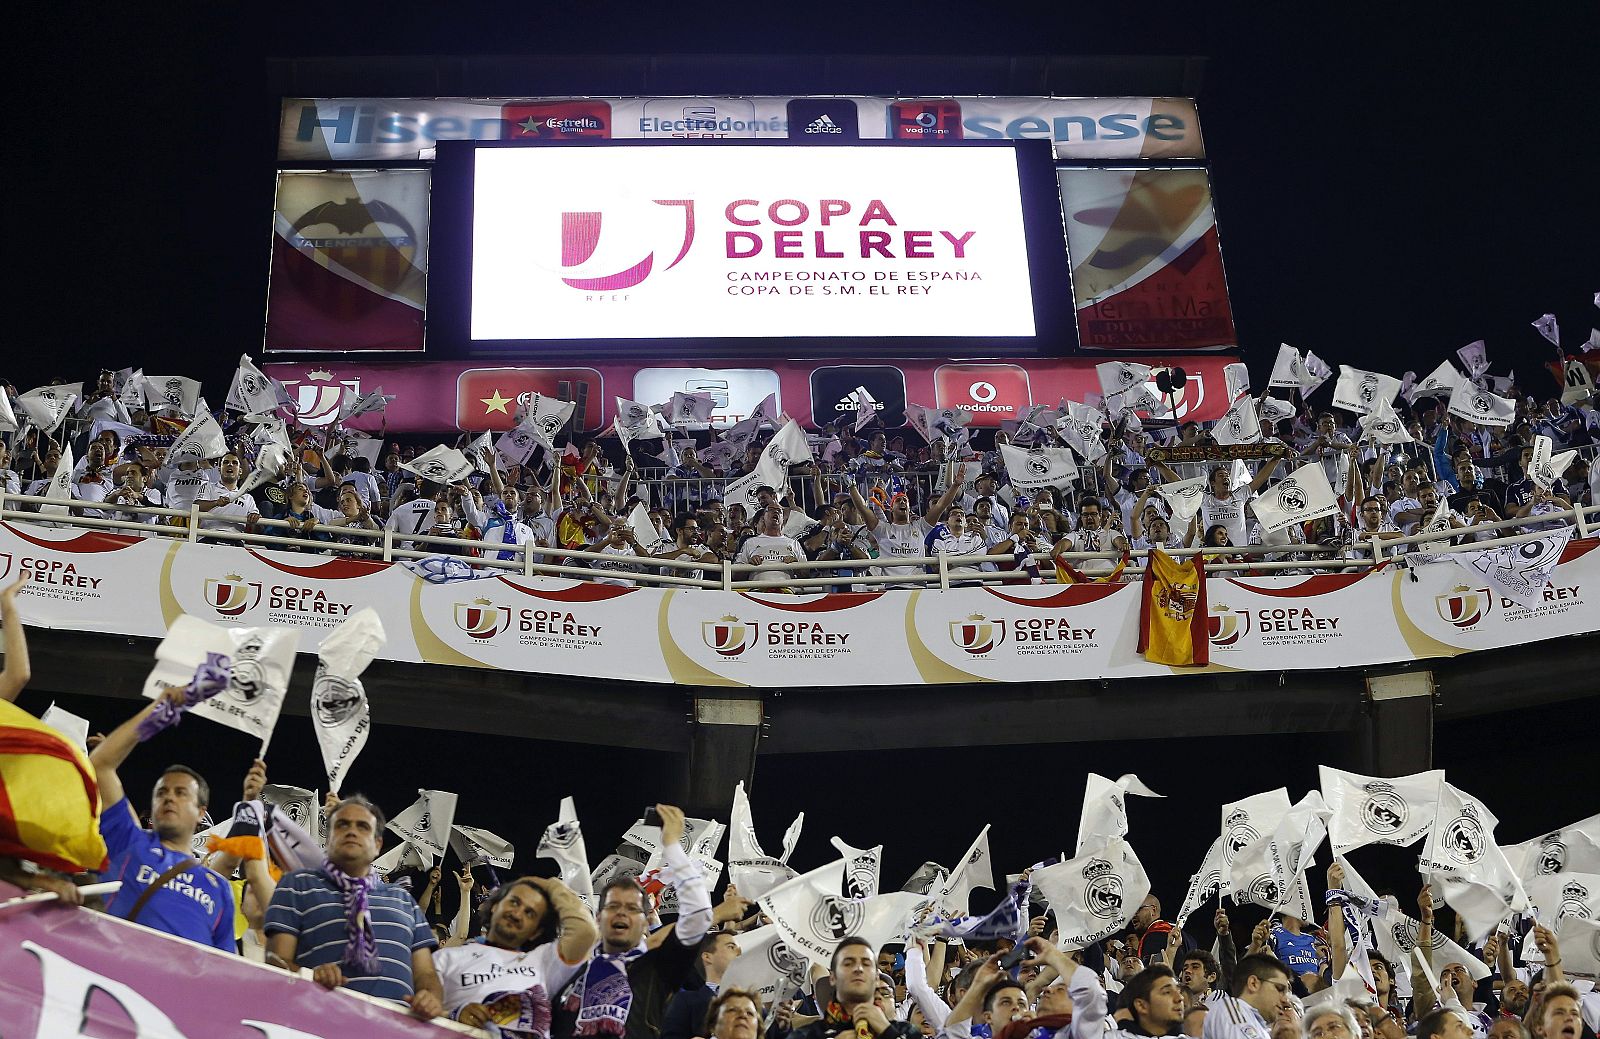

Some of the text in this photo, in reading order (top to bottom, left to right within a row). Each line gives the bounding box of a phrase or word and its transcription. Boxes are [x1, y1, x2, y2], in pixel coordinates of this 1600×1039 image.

[546, 117, 598, 129] Estrella
[805, 125, 842, 134] adidas
[725, 199, 897, 226] COPA
[725, 231, 976, 258] DEL REY
[727, 269, 982, 282] CAMPEONATO DE ESPAÑA
[727, 285, 932, 296] COPA DE S.M. EL REY
[956, 404, 1014, 413] vodafone
[412, 509, 430, 534] 7
[1209, 512, 1239, 520] Emirates
[20, 557, 77, 574] COPA
[600, 561, 633, 570] SIEMENS
[62, 574, 103, 590] REY
[1494, 568, 1534, 597] RESPETO
[270, 585, 328, 602] COPA
[1543, 586, 1580, 602] REY
[269, 597, 353, 616] DEL REY
[1258, 607, 1314, 621] COPA
[268, 612, 315, 621] CAMPEONATO
[519, 608, 577, 624] COPA
[1014, 618, 1071, 630] COPA
[519, 620, 603, 638] DEL REY
[767, 622, 824, 634] COPA
[1259, 617, 1340, 633] DEL REY
[519, 635, 565, 643] CAMPEONATO
[768, 633, 850, 645] DEL REY
[1015, 628, 1097, 642] DEL REY
[209, 698, 247, 718] DEL REY
[340, 735, 357, 759] COPA
[777, 916, 832, 958] COPA DEL REY
[1064, 935, 1085, 944] FINAL
[1086, 930, 1106, 942] COPA
[1105, 920, 1118, 933] DEL
[1288, 956, 1318, 966] Emirat
